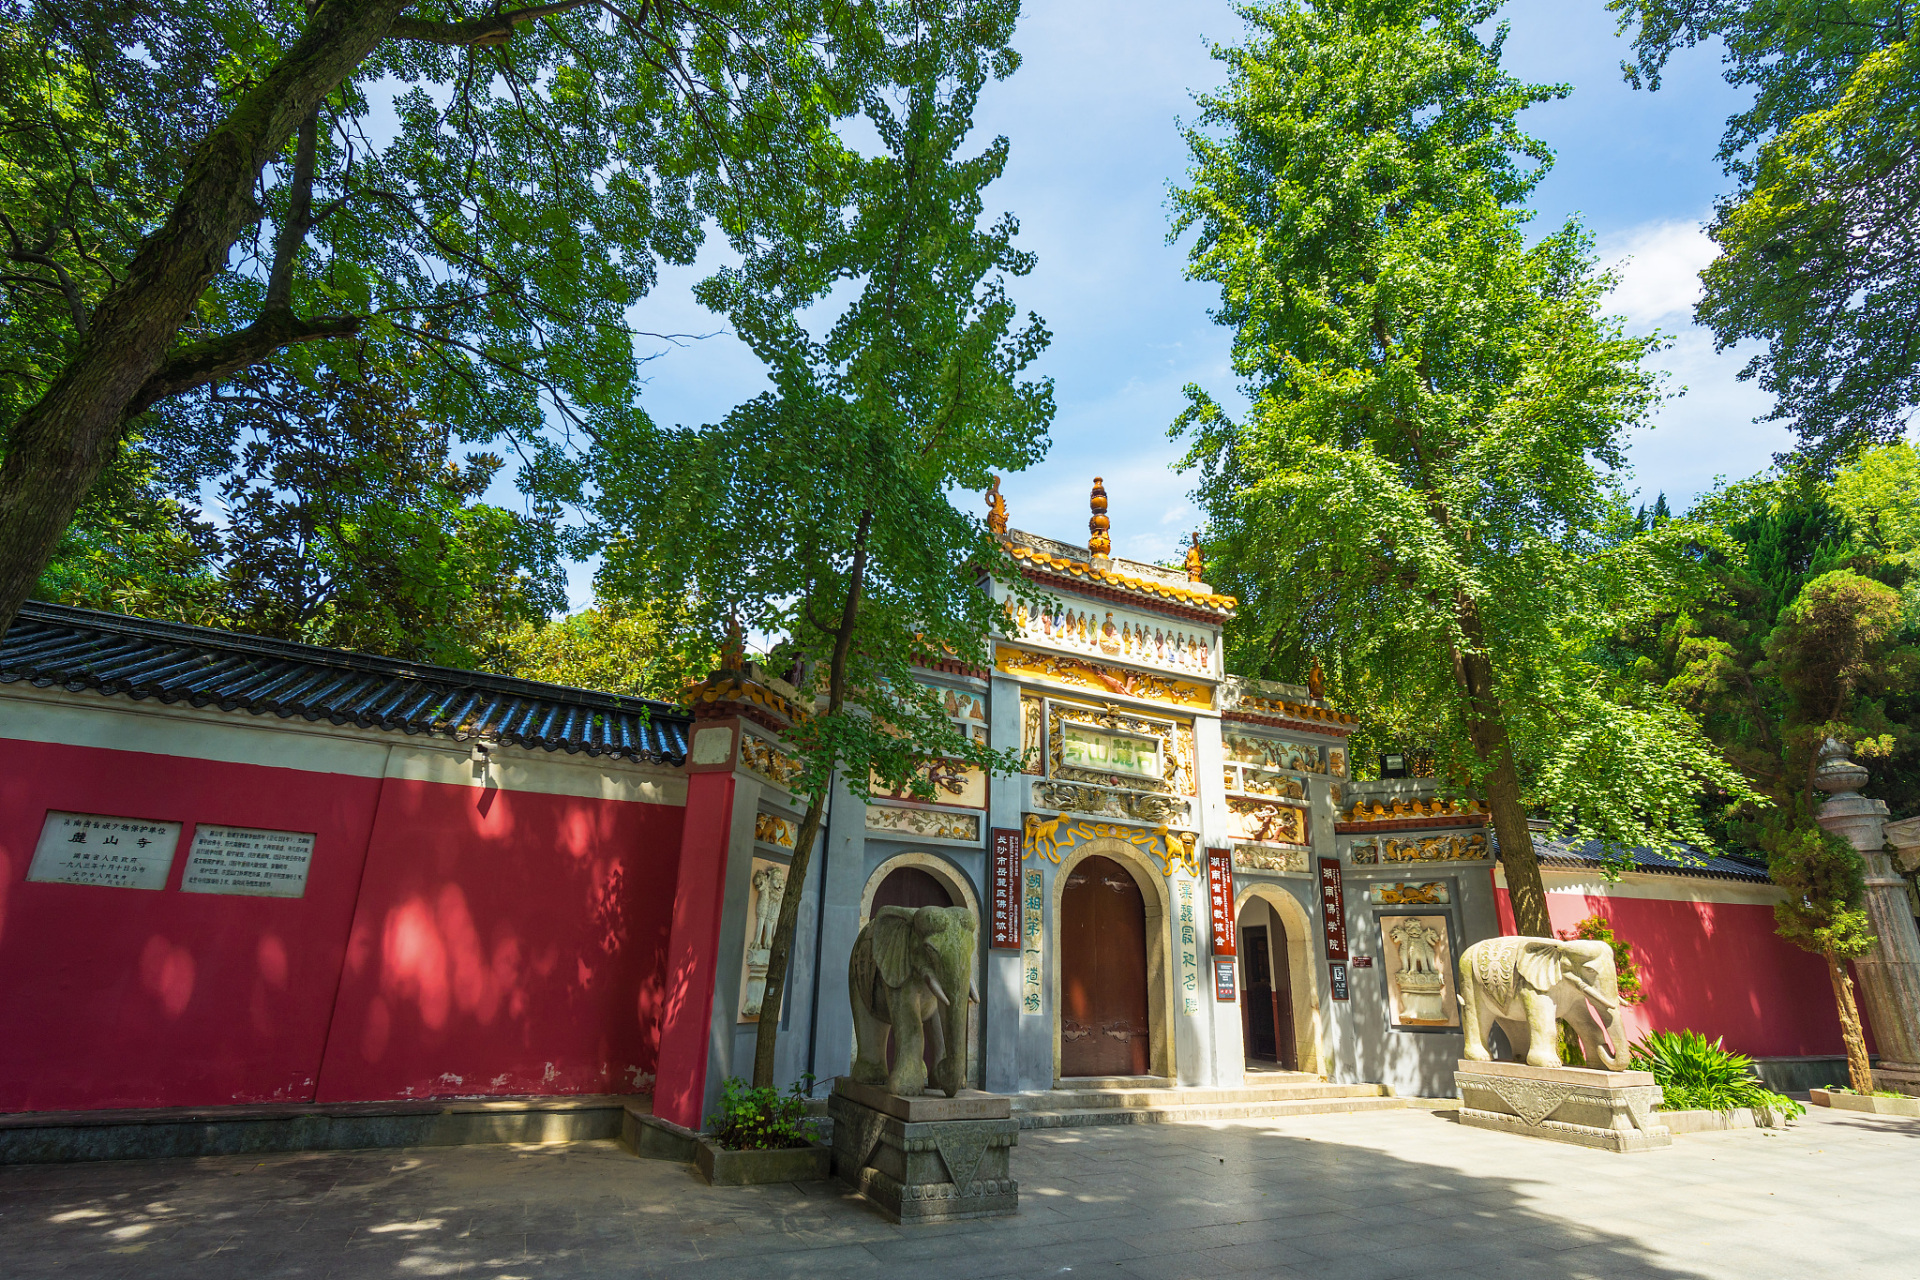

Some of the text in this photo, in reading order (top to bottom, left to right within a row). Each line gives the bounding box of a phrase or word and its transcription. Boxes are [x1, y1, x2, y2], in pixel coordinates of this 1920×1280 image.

[68, 832, 153, 848] 麓山寺
[73, 852, 139, 864] 湖南省人民政府
[1323, 868, 1340, 951] 湖南佛学院
